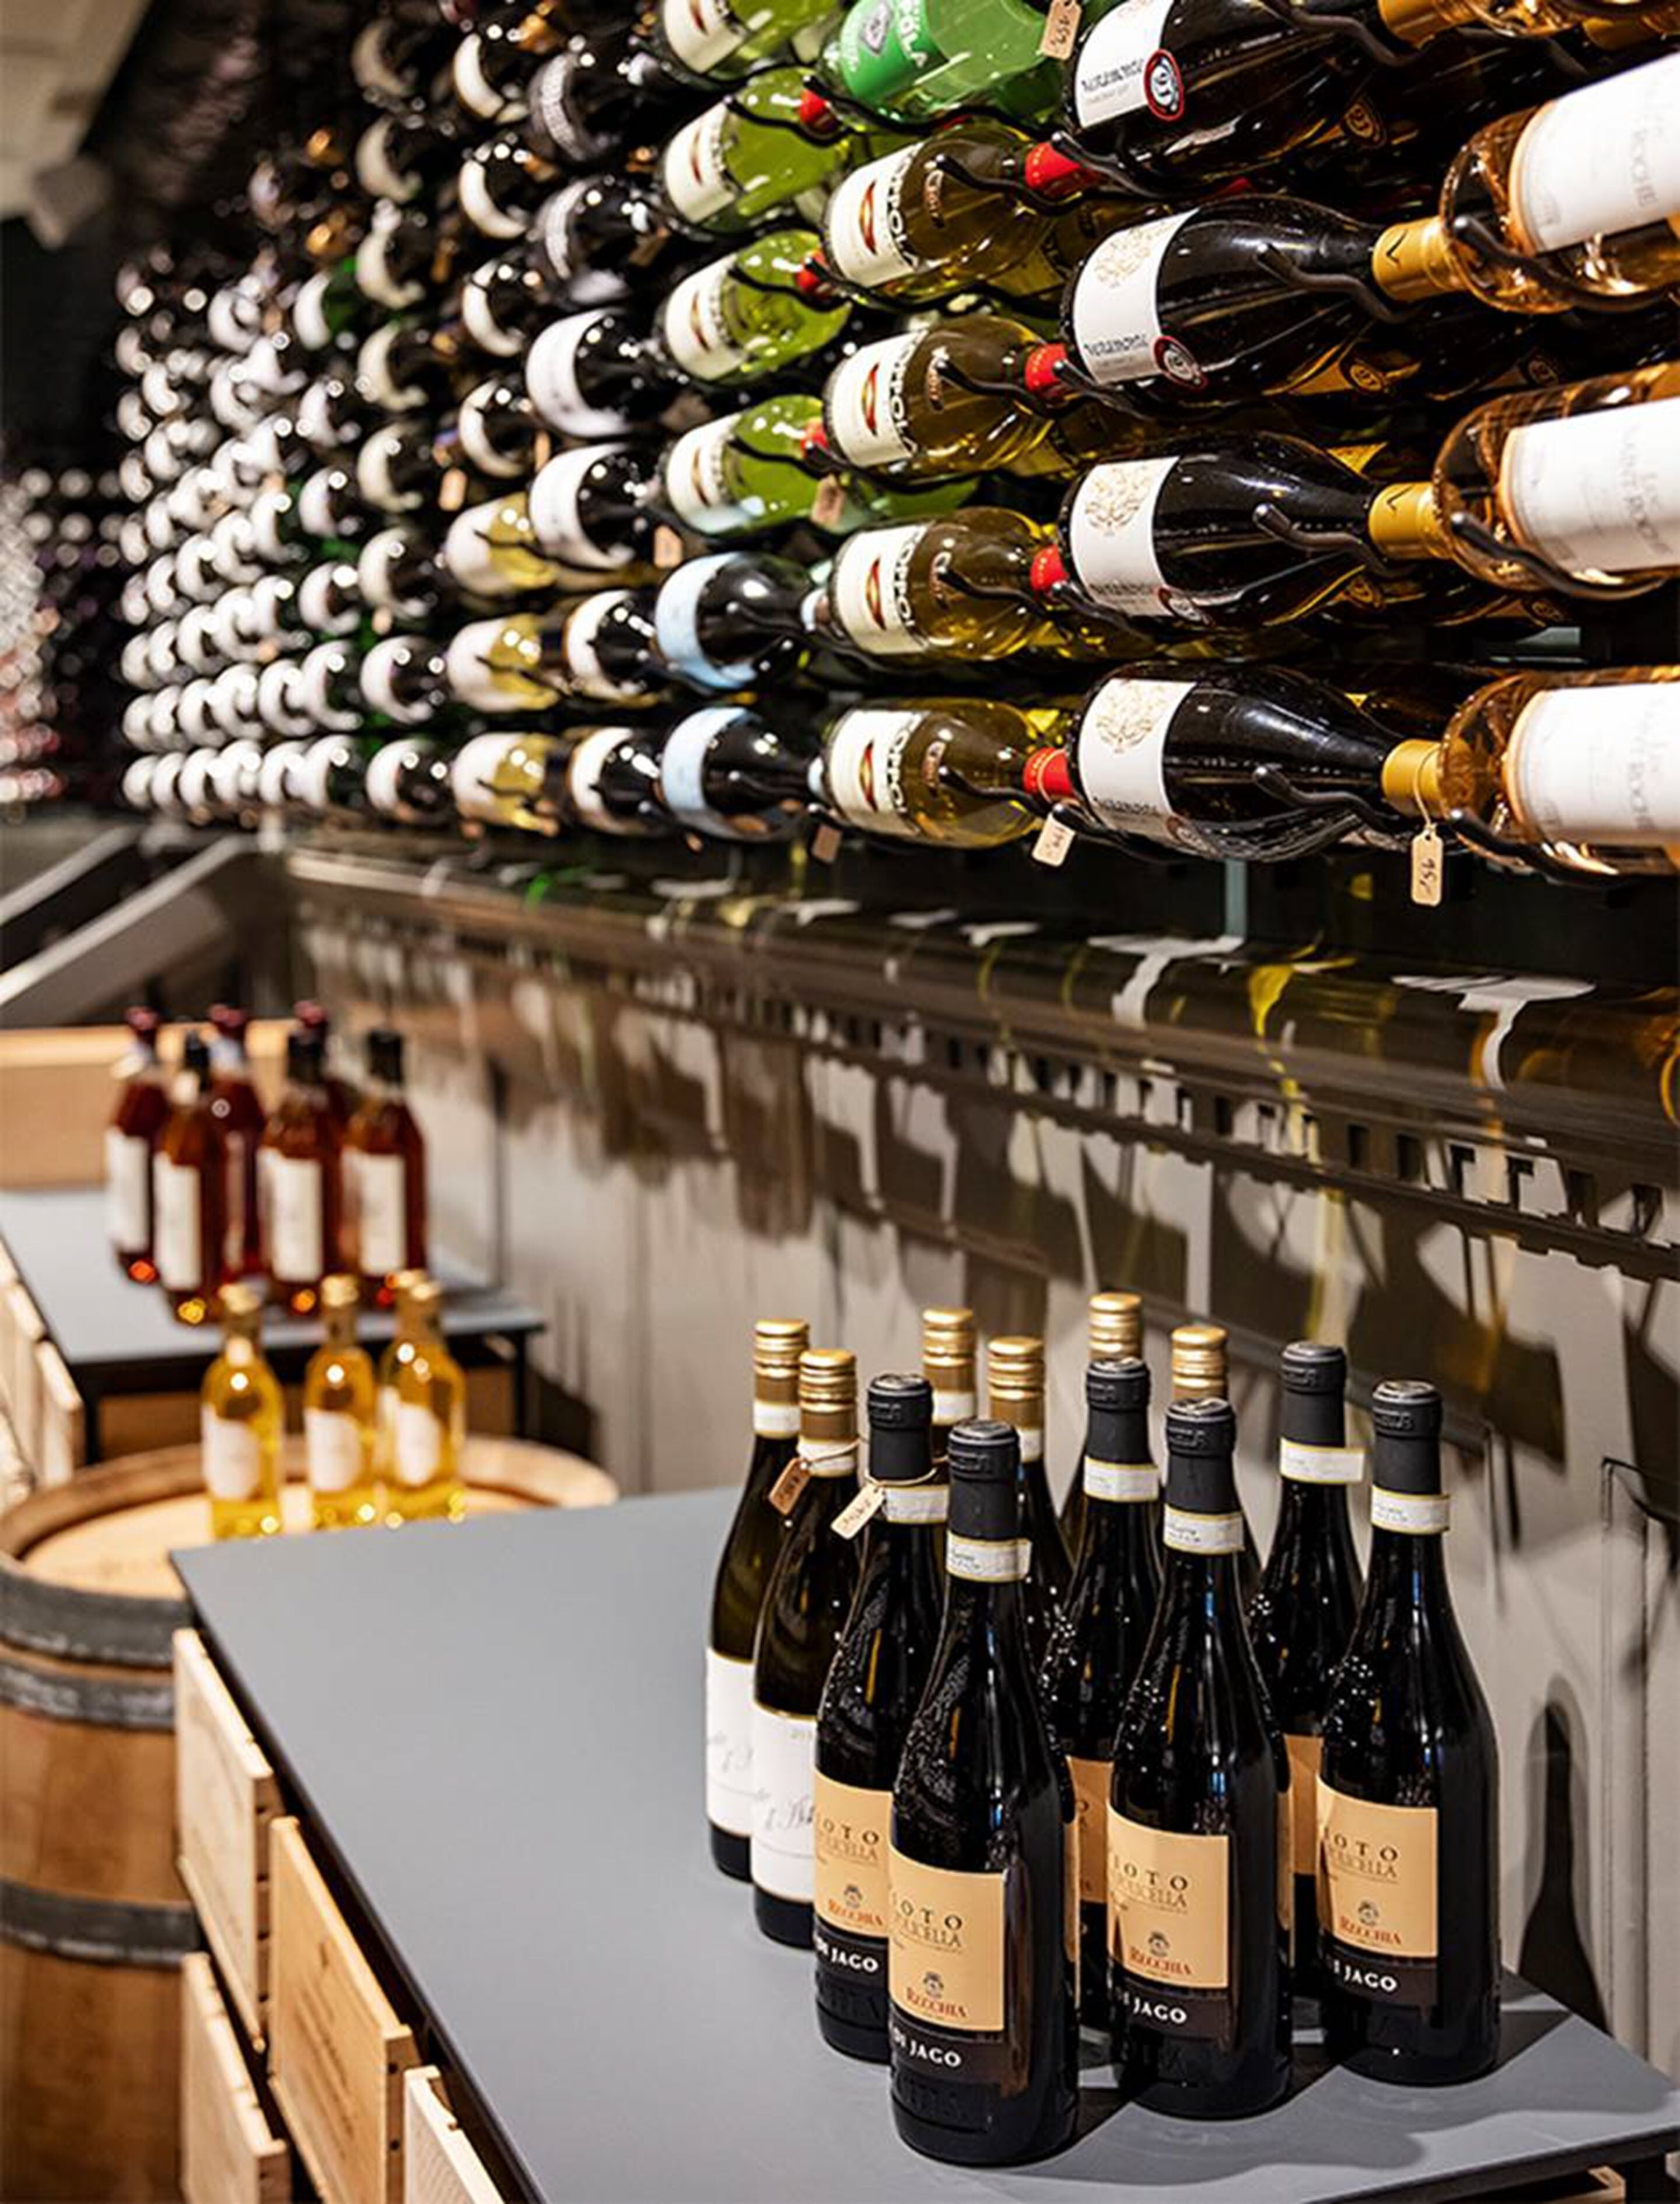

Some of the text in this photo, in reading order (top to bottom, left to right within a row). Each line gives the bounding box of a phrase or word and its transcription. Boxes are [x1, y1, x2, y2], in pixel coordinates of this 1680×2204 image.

[831, 1948, 878, 1972] JAGO
[1344, 1965, 1397, 1992] JAGO
[1133, 1997, 1187, 2024] JAGO
[910, 2041, 961, 2067] JAGO
